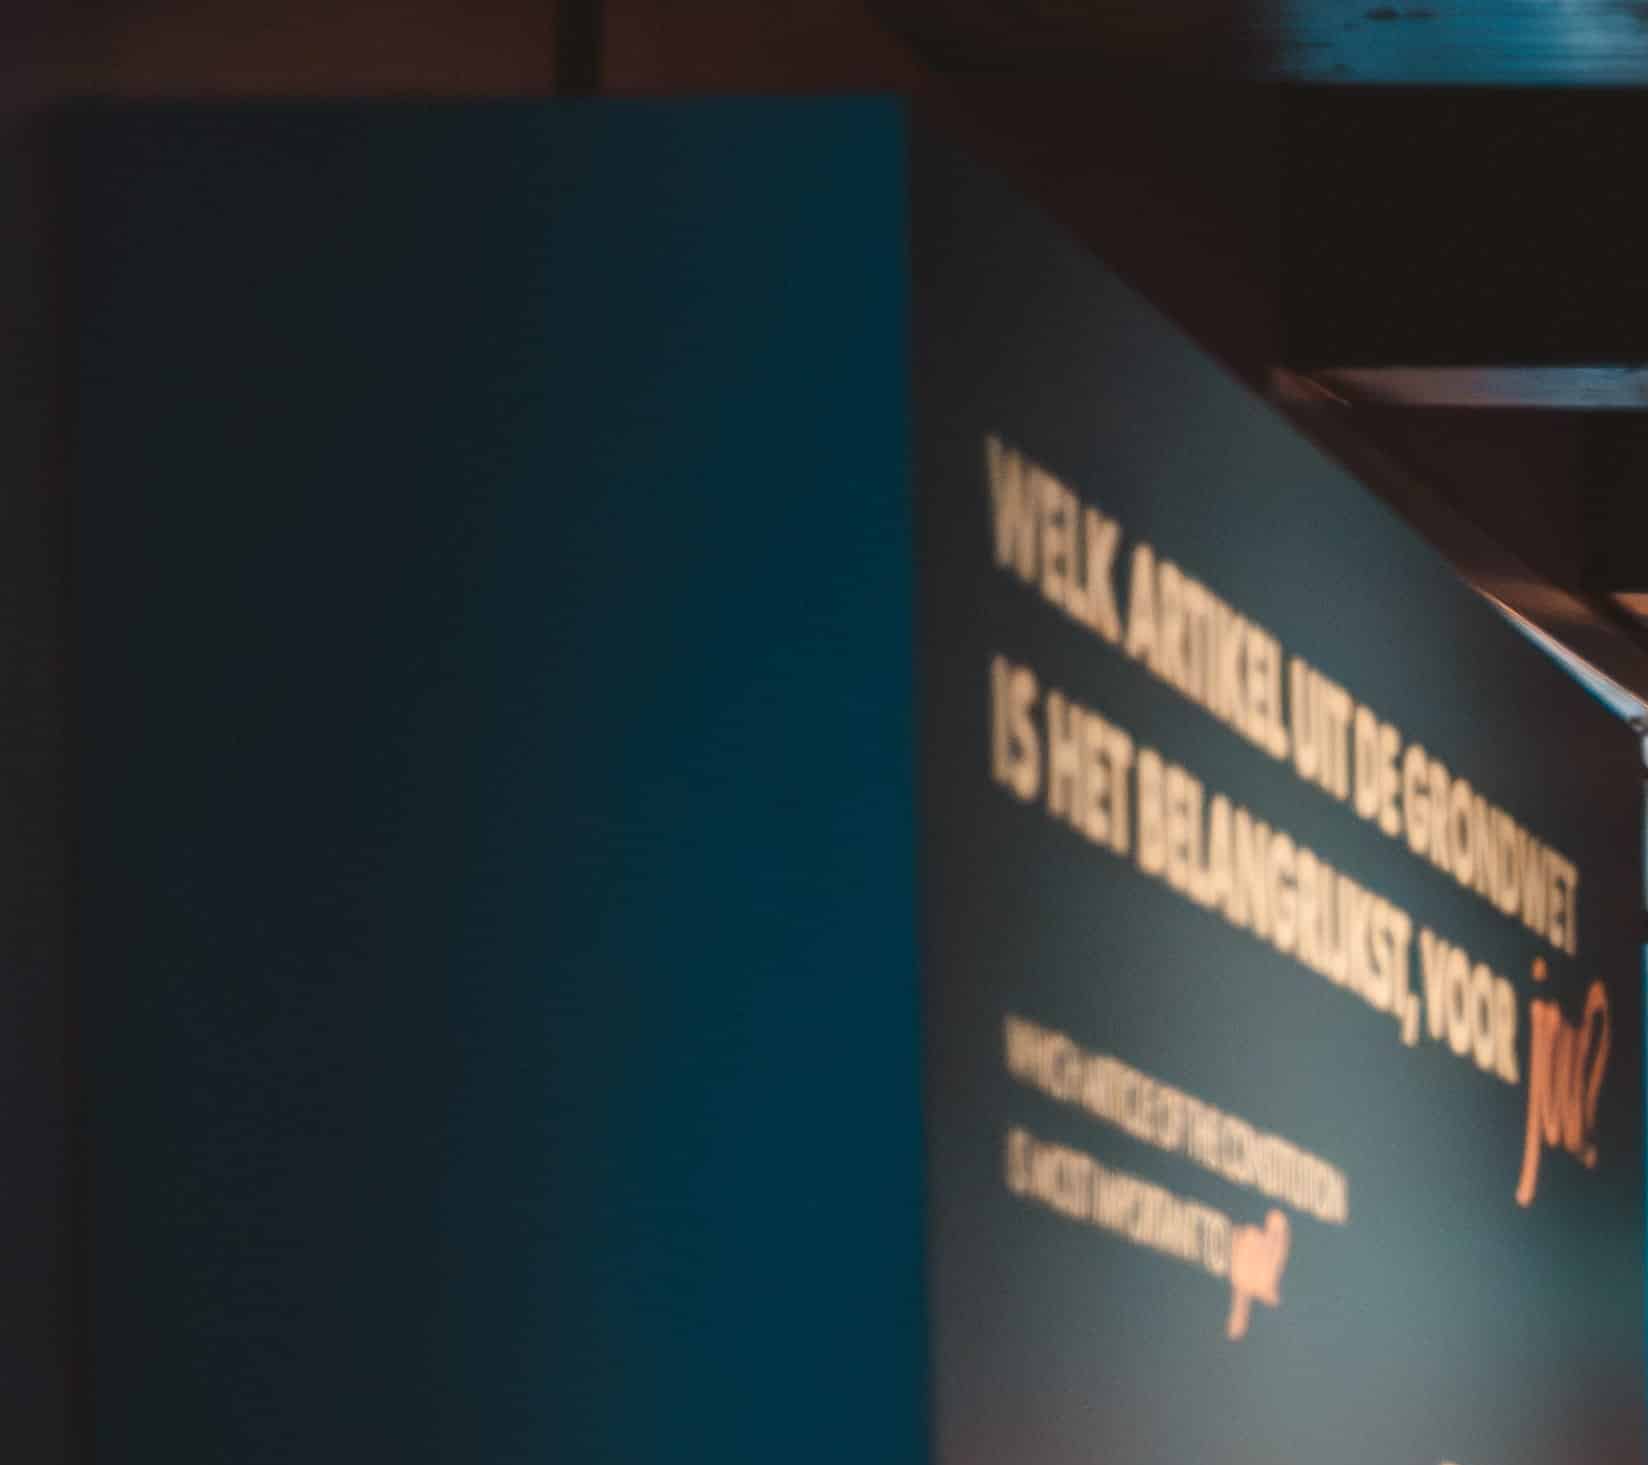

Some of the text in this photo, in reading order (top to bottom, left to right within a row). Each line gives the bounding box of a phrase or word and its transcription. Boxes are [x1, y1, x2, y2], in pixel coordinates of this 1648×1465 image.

[985, 433, 1578, 957] WELK ARTIKEL UIT DE GRONDWET
[992, 653, 1040, 800] IS
[1045, 688, 1135, 856] HET
[1418, 927, 1520, 1086] VOOR
